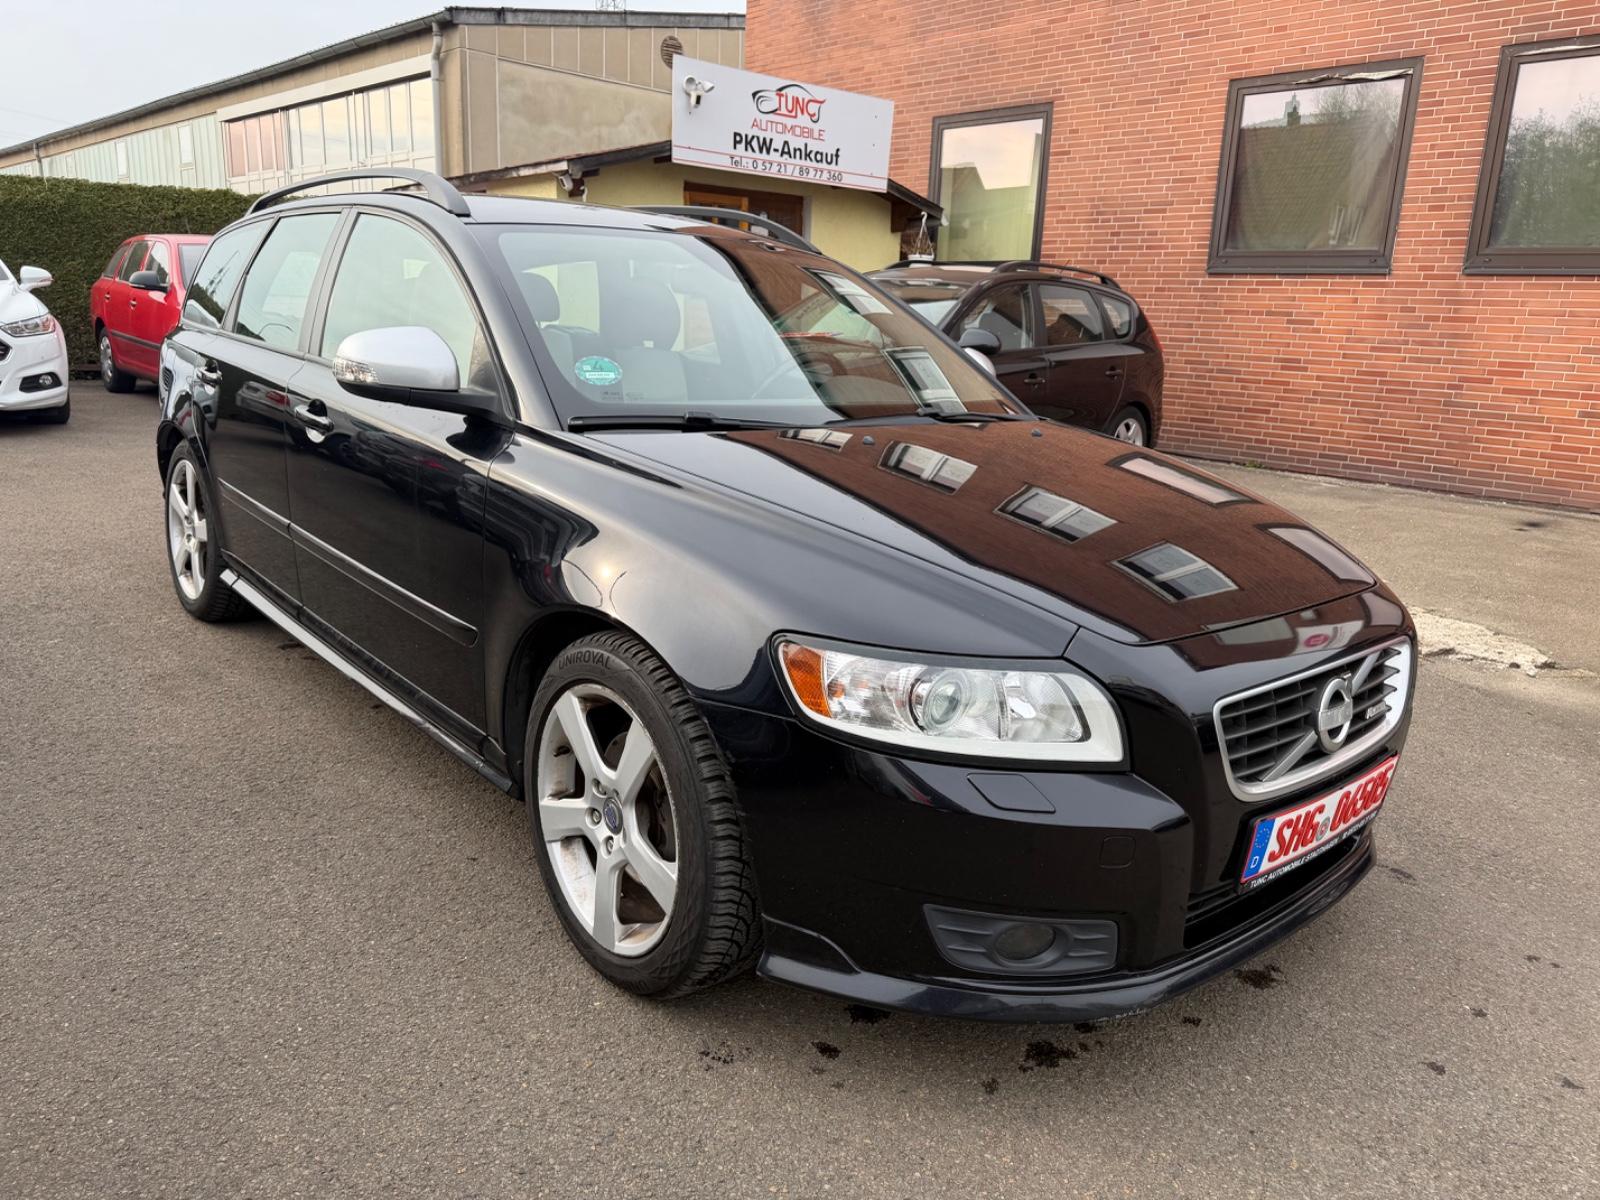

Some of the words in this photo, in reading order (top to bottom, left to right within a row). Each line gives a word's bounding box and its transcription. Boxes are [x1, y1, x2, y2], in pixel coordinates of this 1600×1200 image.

[751, 117, 825, 142] AUTOMOBILE
[733, 131, 840, 166] PKW-Ankauf
[730, 156, 749, 168] Tel.:
[752, 160, 758, 170] 0
[761, 161, 773, 171] 57
[776, 163, 788, 173] 21
[790, 166, 796, 176] /
[798, 166, 810, 177] 89
[813, 169, 824, 179] 77
[826, 170, 843, 182] 360
[558, 650, 611, 670] UNIROYAL
[1268, 804, 1326, 863] SHG
[1250, 855, 1259, 868] D
